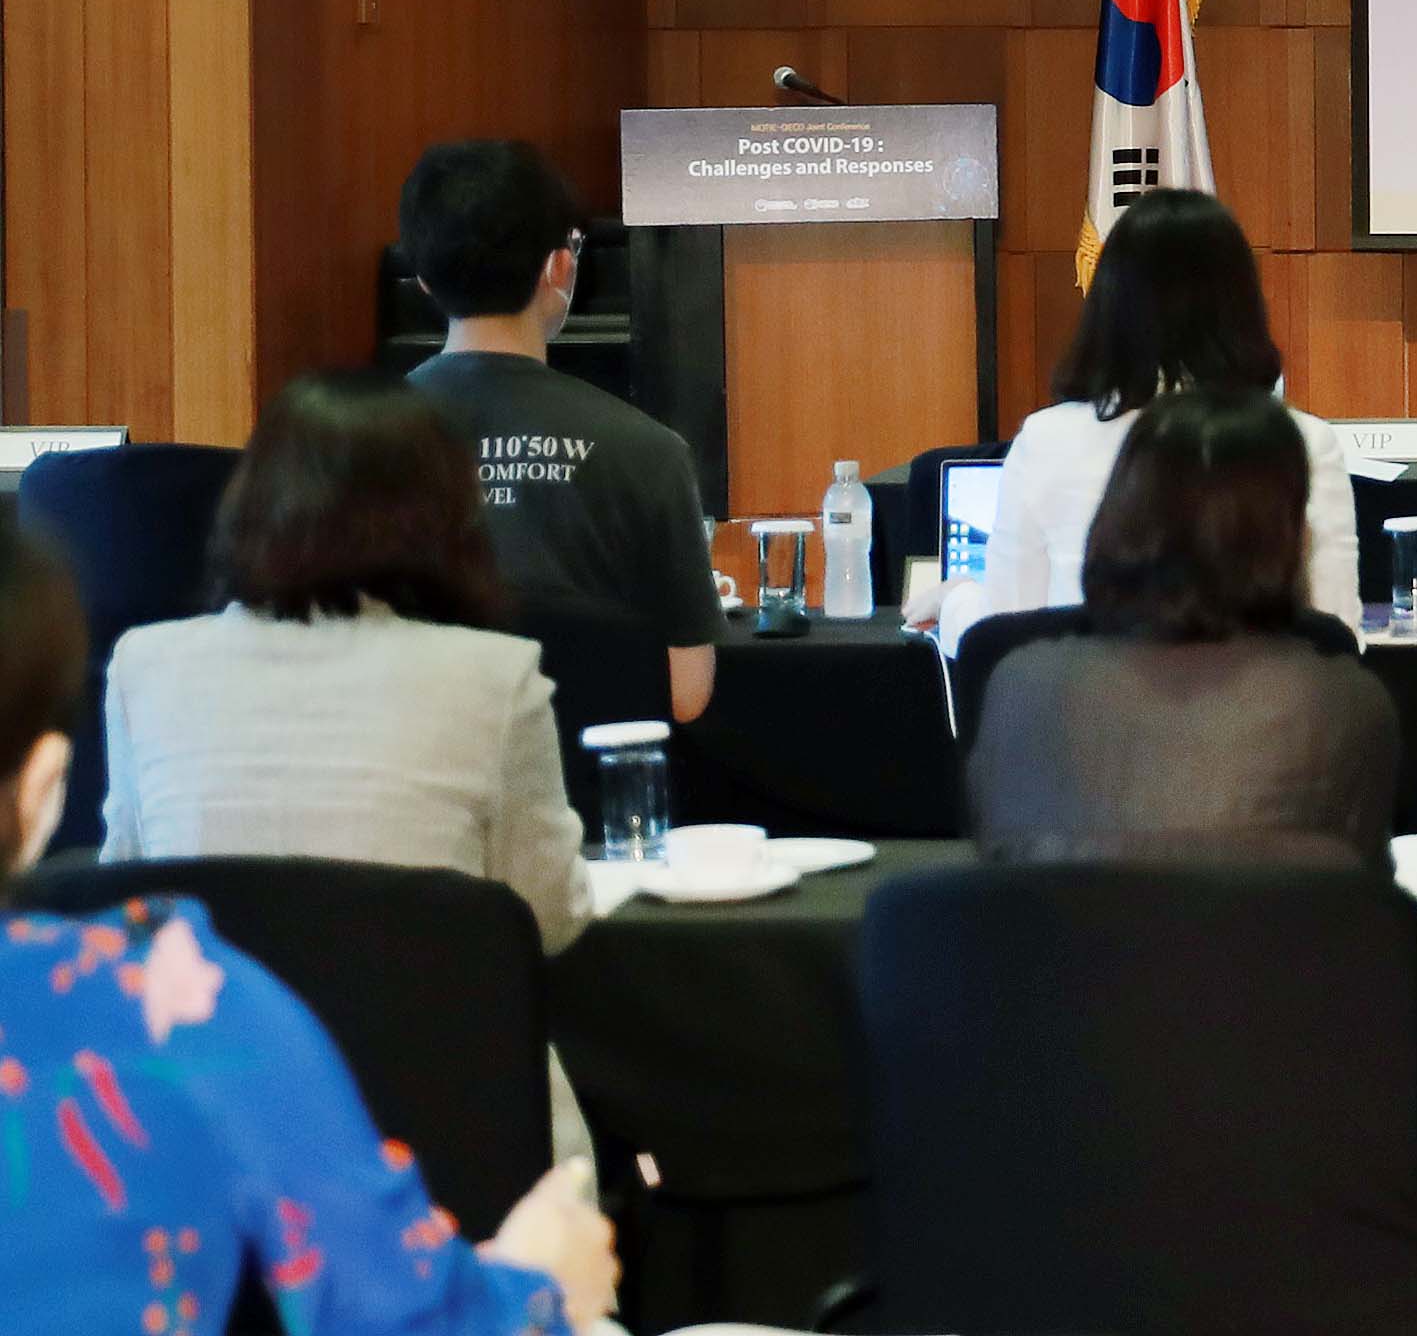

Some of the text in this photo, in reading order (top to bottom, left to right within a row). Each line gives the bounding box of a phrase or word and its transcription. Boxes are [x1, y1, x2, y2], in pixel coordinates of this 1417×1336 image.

[738, 138, 780, 155] Post
[687, 157, 934, 180] Challenges and Responses
[562, 437, 595, 461] W
[1352, 432, 1393, 450] VIP
